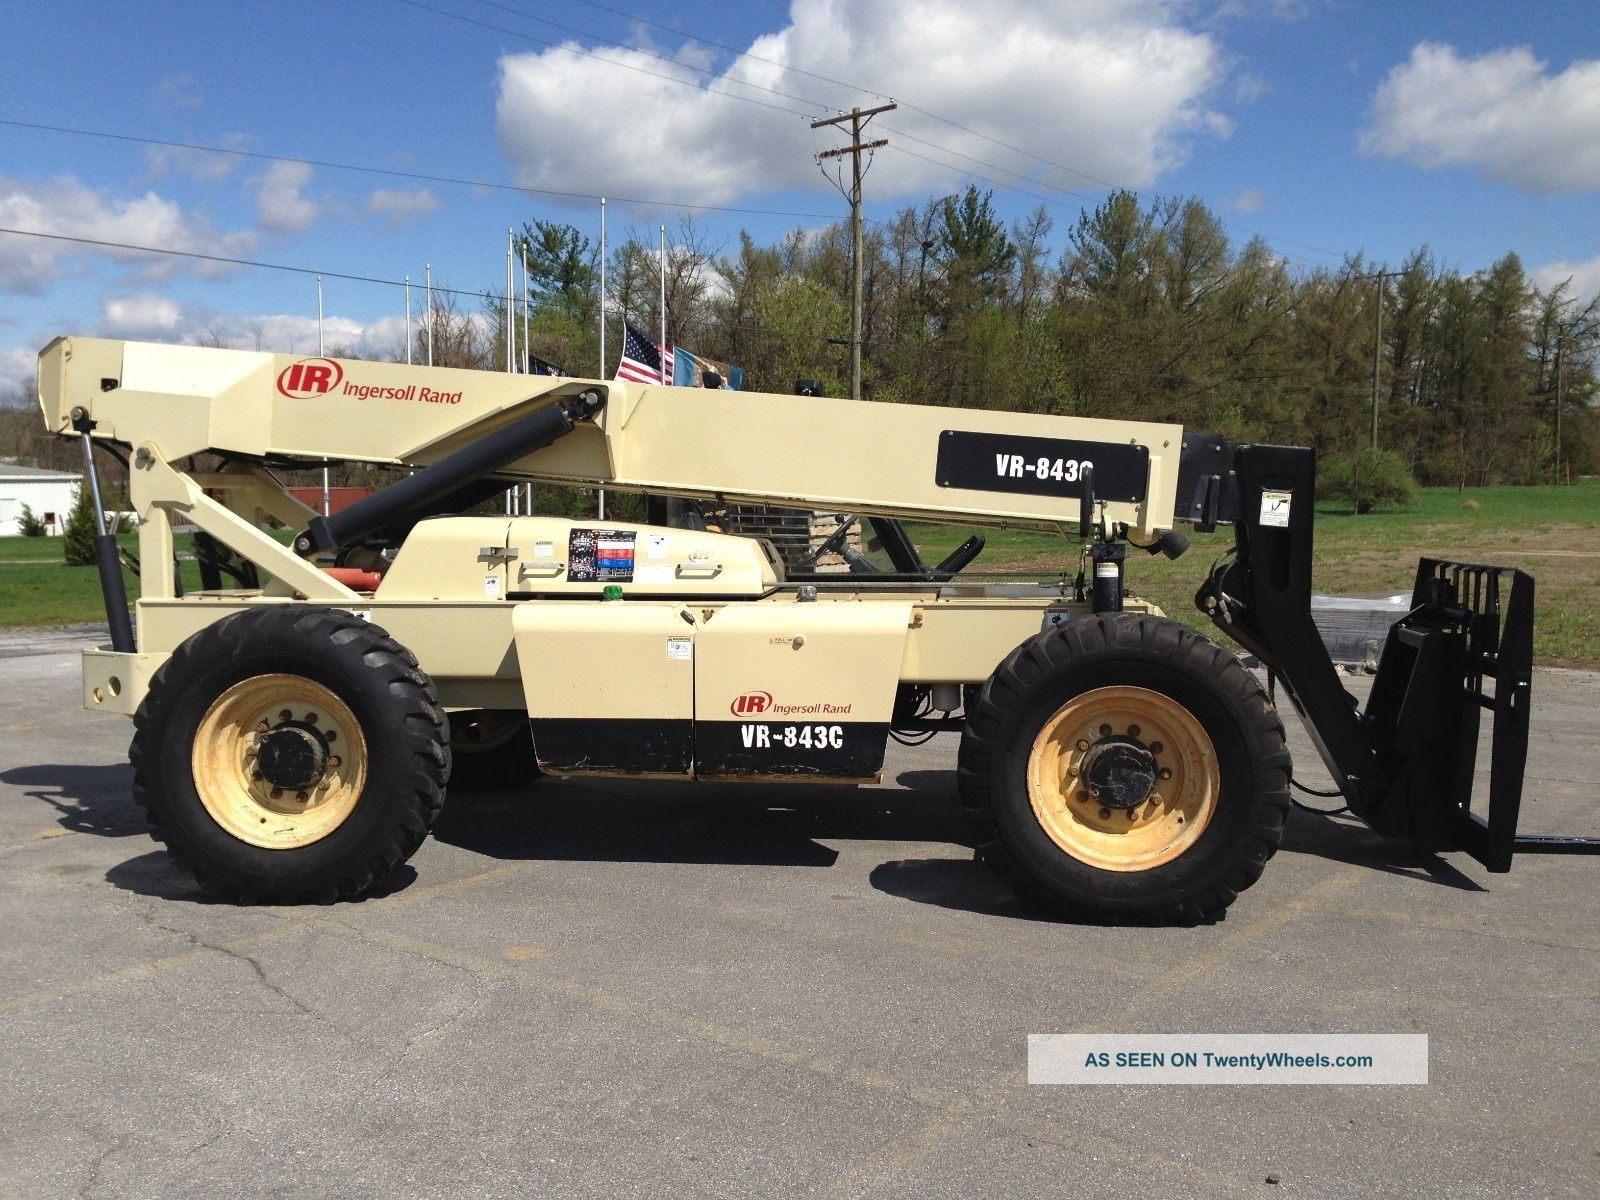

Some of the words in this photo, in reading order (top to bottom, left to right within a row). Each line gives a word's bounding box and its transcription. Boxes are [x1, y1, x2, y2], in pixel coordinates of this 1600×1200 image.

[287, 364, 332, 393] IR
[343, 381, 416, 401] Ingersoll
[419, 387, 463, 404] Rand
[737, 696, 766, 713] IR
[773, 703, 821, 716] Ingersoll
[823, 704, 852, 714] Rand
[741, 725, 844, 749] VR-843C
